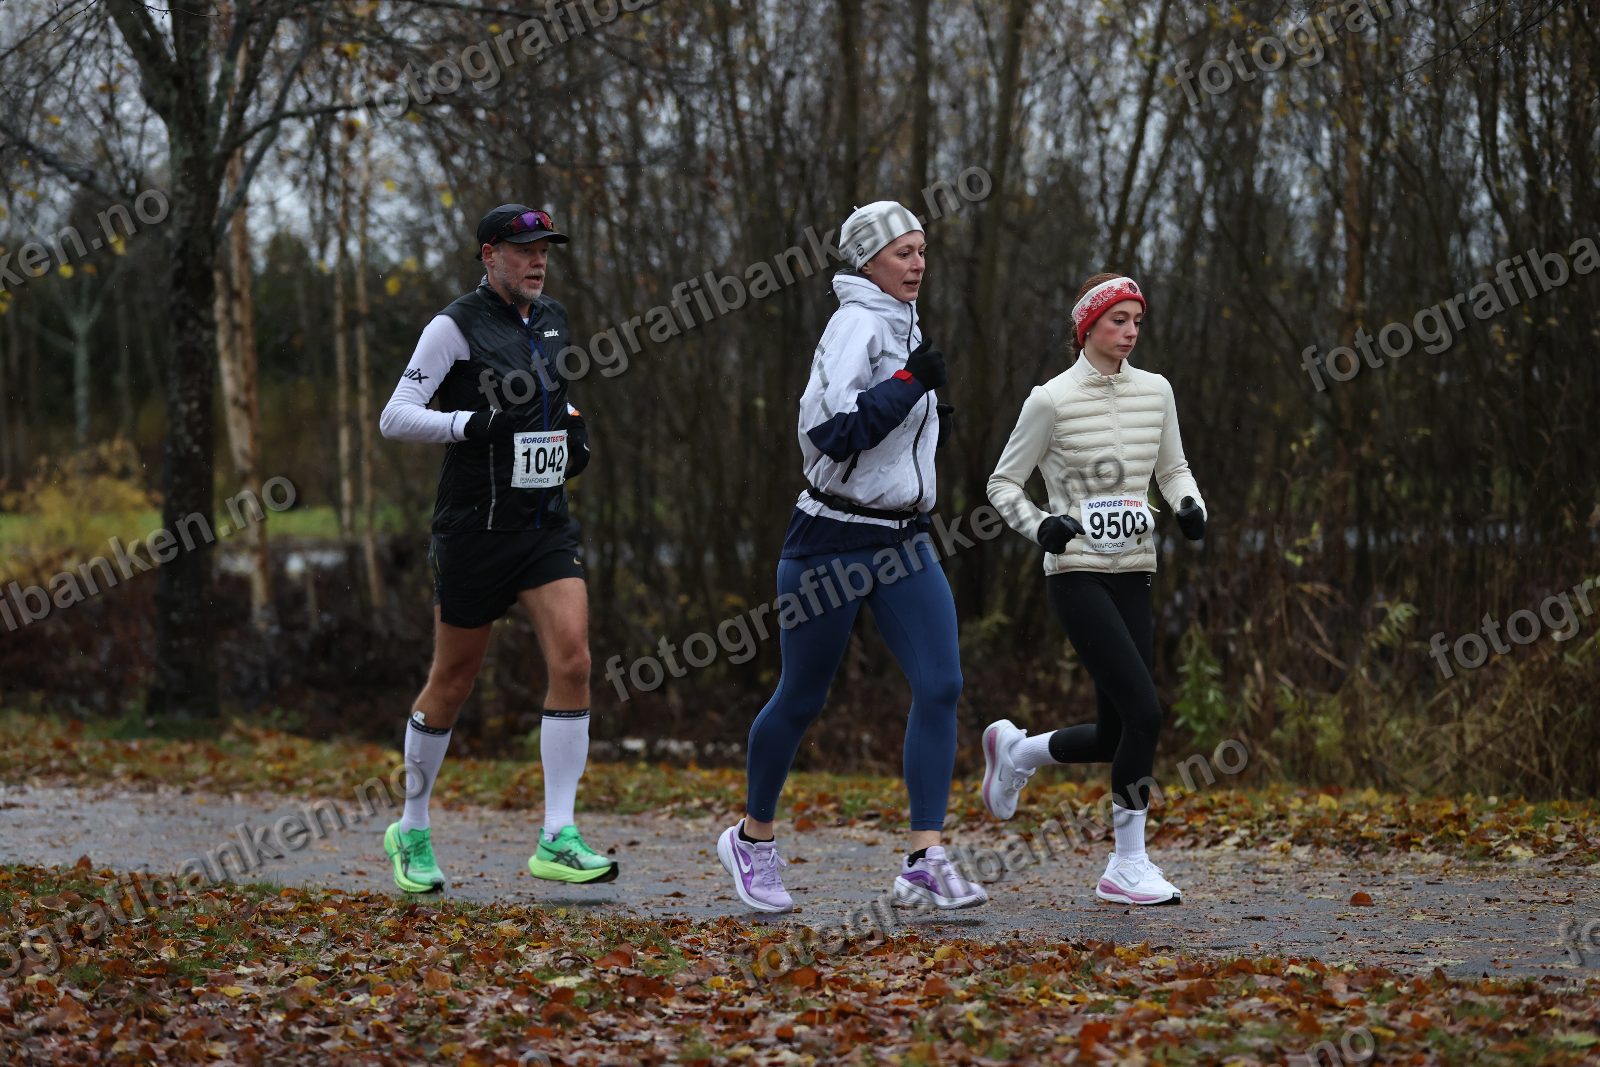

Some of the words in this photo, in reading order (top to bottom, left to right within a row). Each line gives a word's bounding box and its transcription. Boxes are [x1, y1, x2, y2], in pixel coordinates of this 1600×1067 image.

[521, 445, 565, 475] 1042
[1087, 499, 1143, 510] NORGESTESTEN
[1089, 510, 1149, 540] 9503
